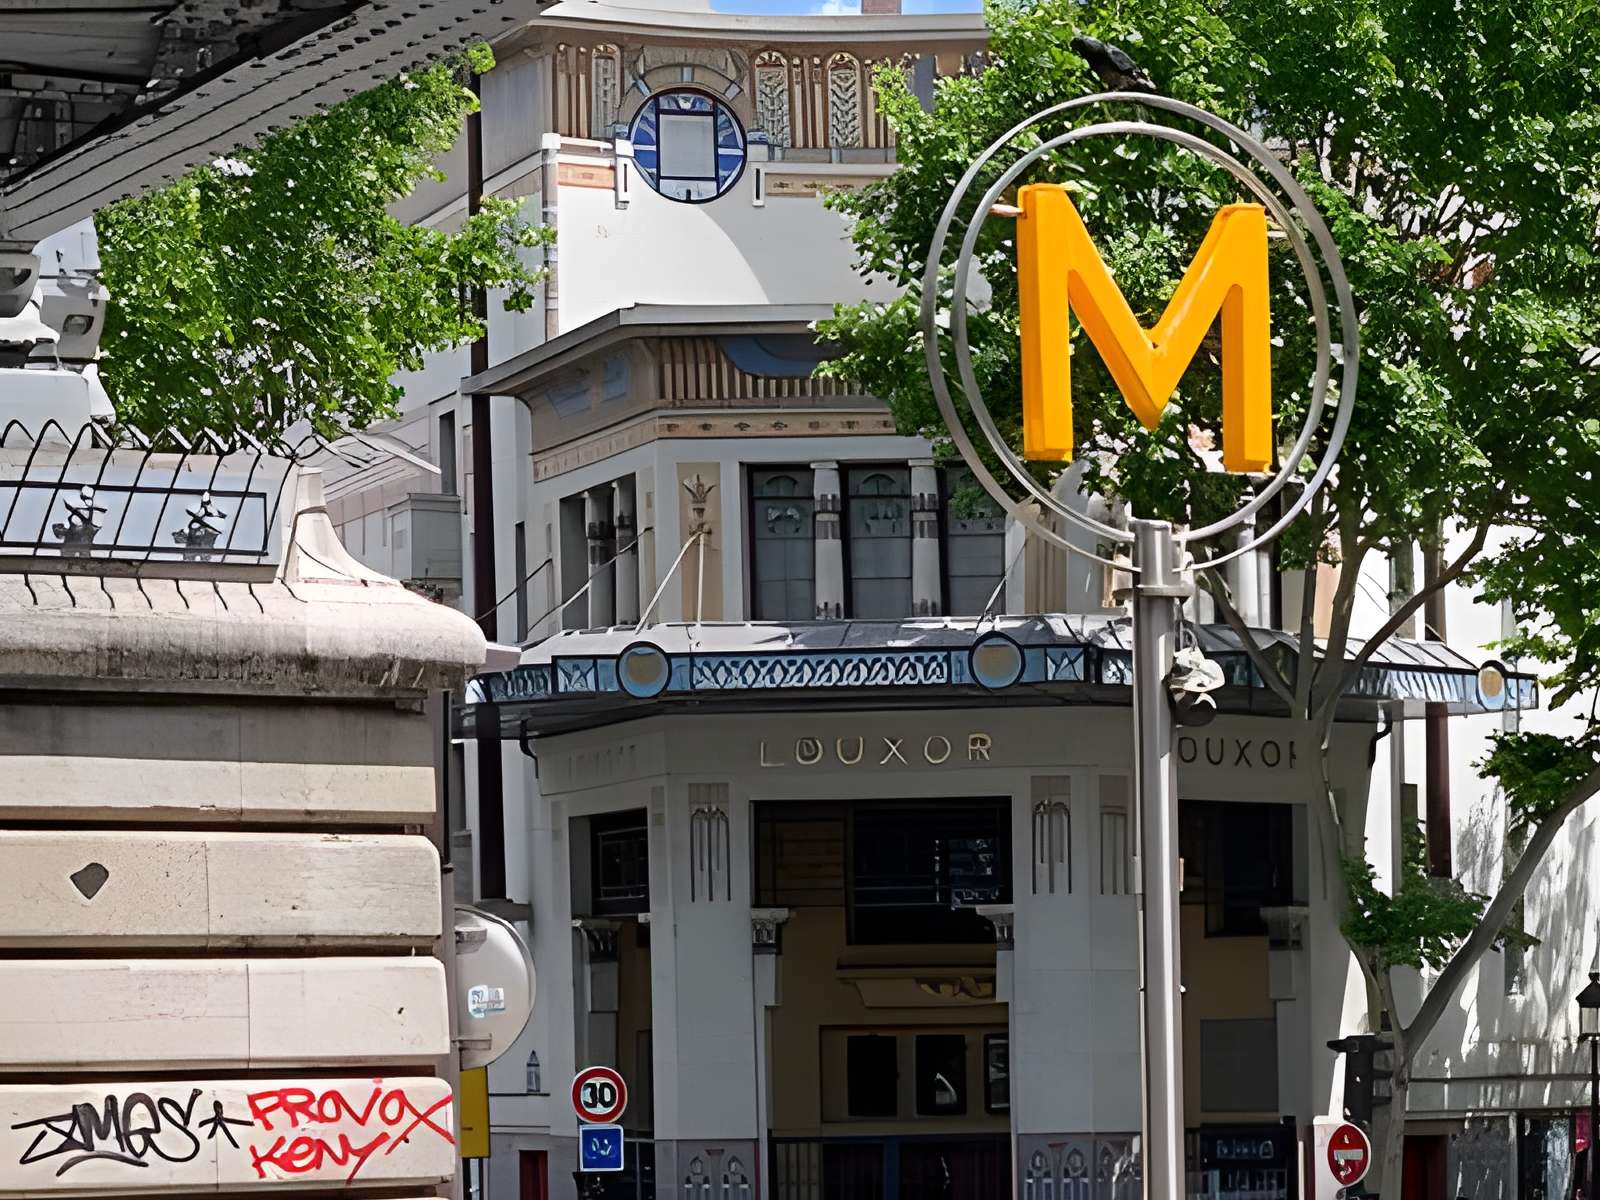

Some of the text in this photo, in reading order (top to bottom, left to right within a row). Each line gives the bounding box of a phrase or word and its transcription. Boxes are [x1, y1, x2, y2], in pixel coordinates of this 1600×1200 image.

[1016, 183, 1273, 473] M
[760, 733, 993, 767] LOUXOR
[583, 1082, 617, 1109] 30
